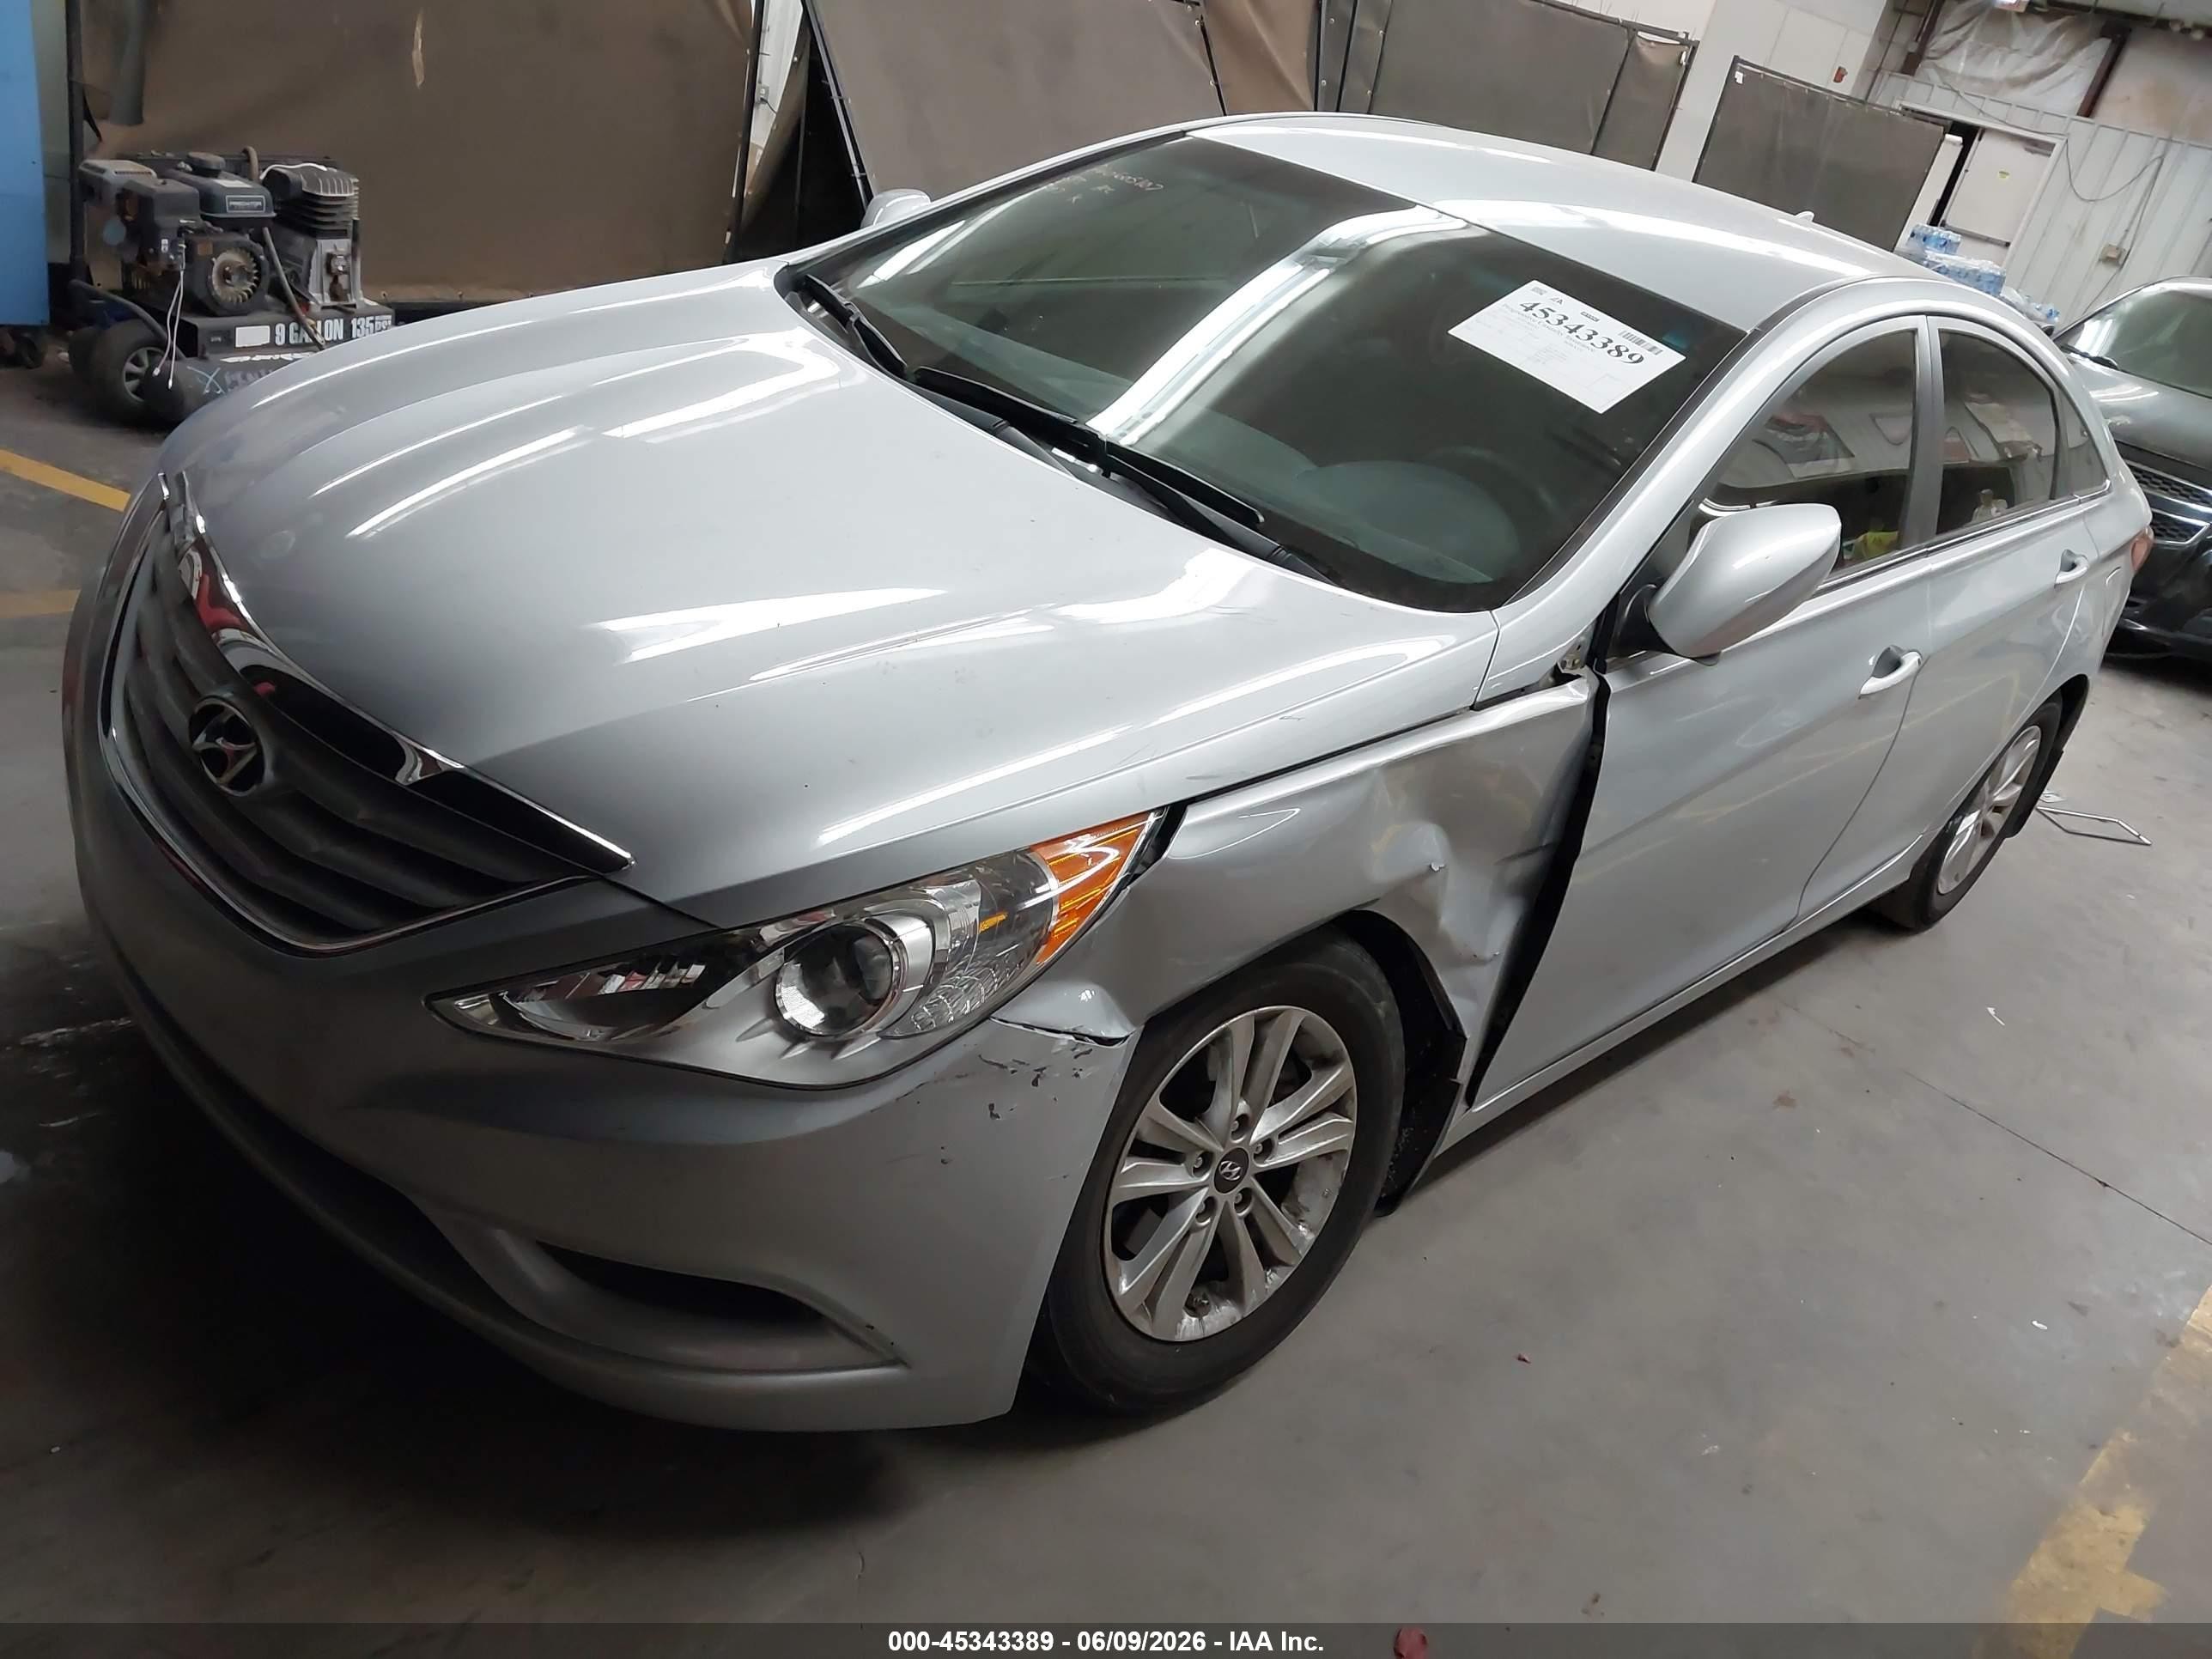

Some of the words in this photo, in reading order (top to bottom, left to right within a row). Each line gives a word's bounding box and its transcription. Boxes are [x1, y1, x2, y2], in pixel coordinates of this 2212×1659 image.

[275, 323, 286, 346] 9
[351, 316, 374, 338] 135
[1520, 301, 1644, 364] 45343389
